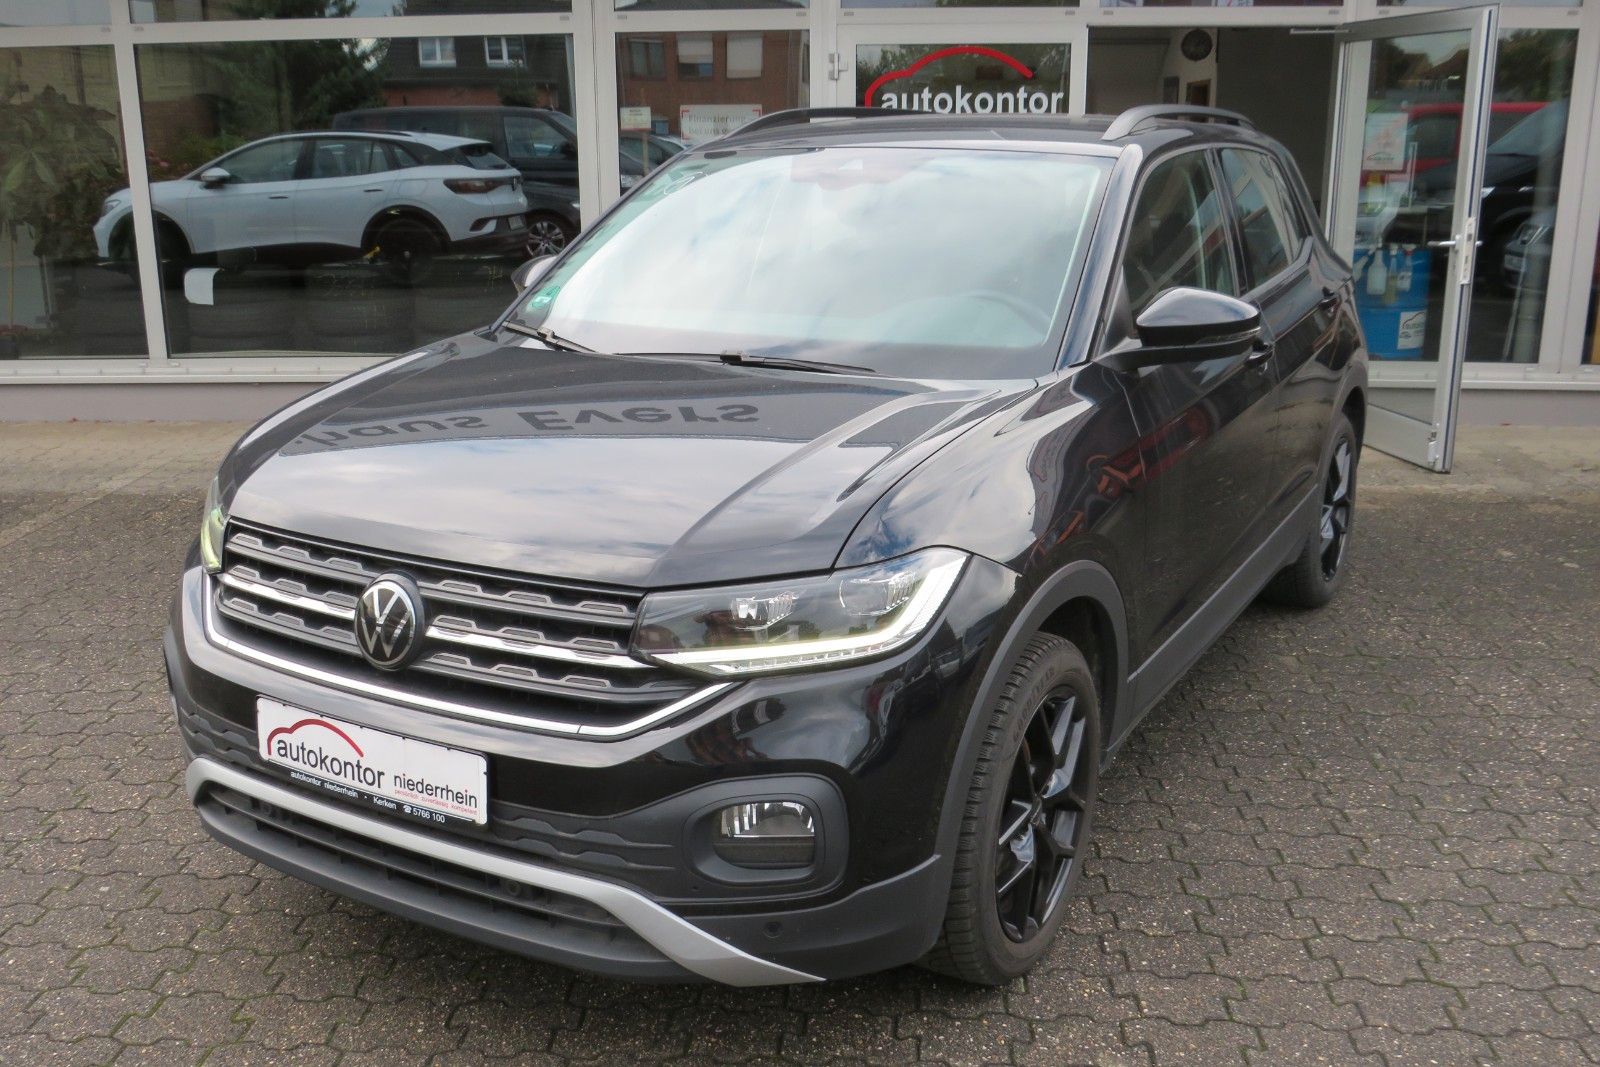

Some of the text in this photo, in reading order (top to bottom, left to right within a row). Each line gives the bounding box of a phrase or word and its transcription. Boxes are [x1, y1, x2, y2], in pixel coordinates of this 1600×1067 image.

[881, 84, 1064, 114] autokontor
[277, 739, 478, 809] autokontor niederrhein
[290, 770, 446, 824] autokontor niederrhein Kerken 5766 100
